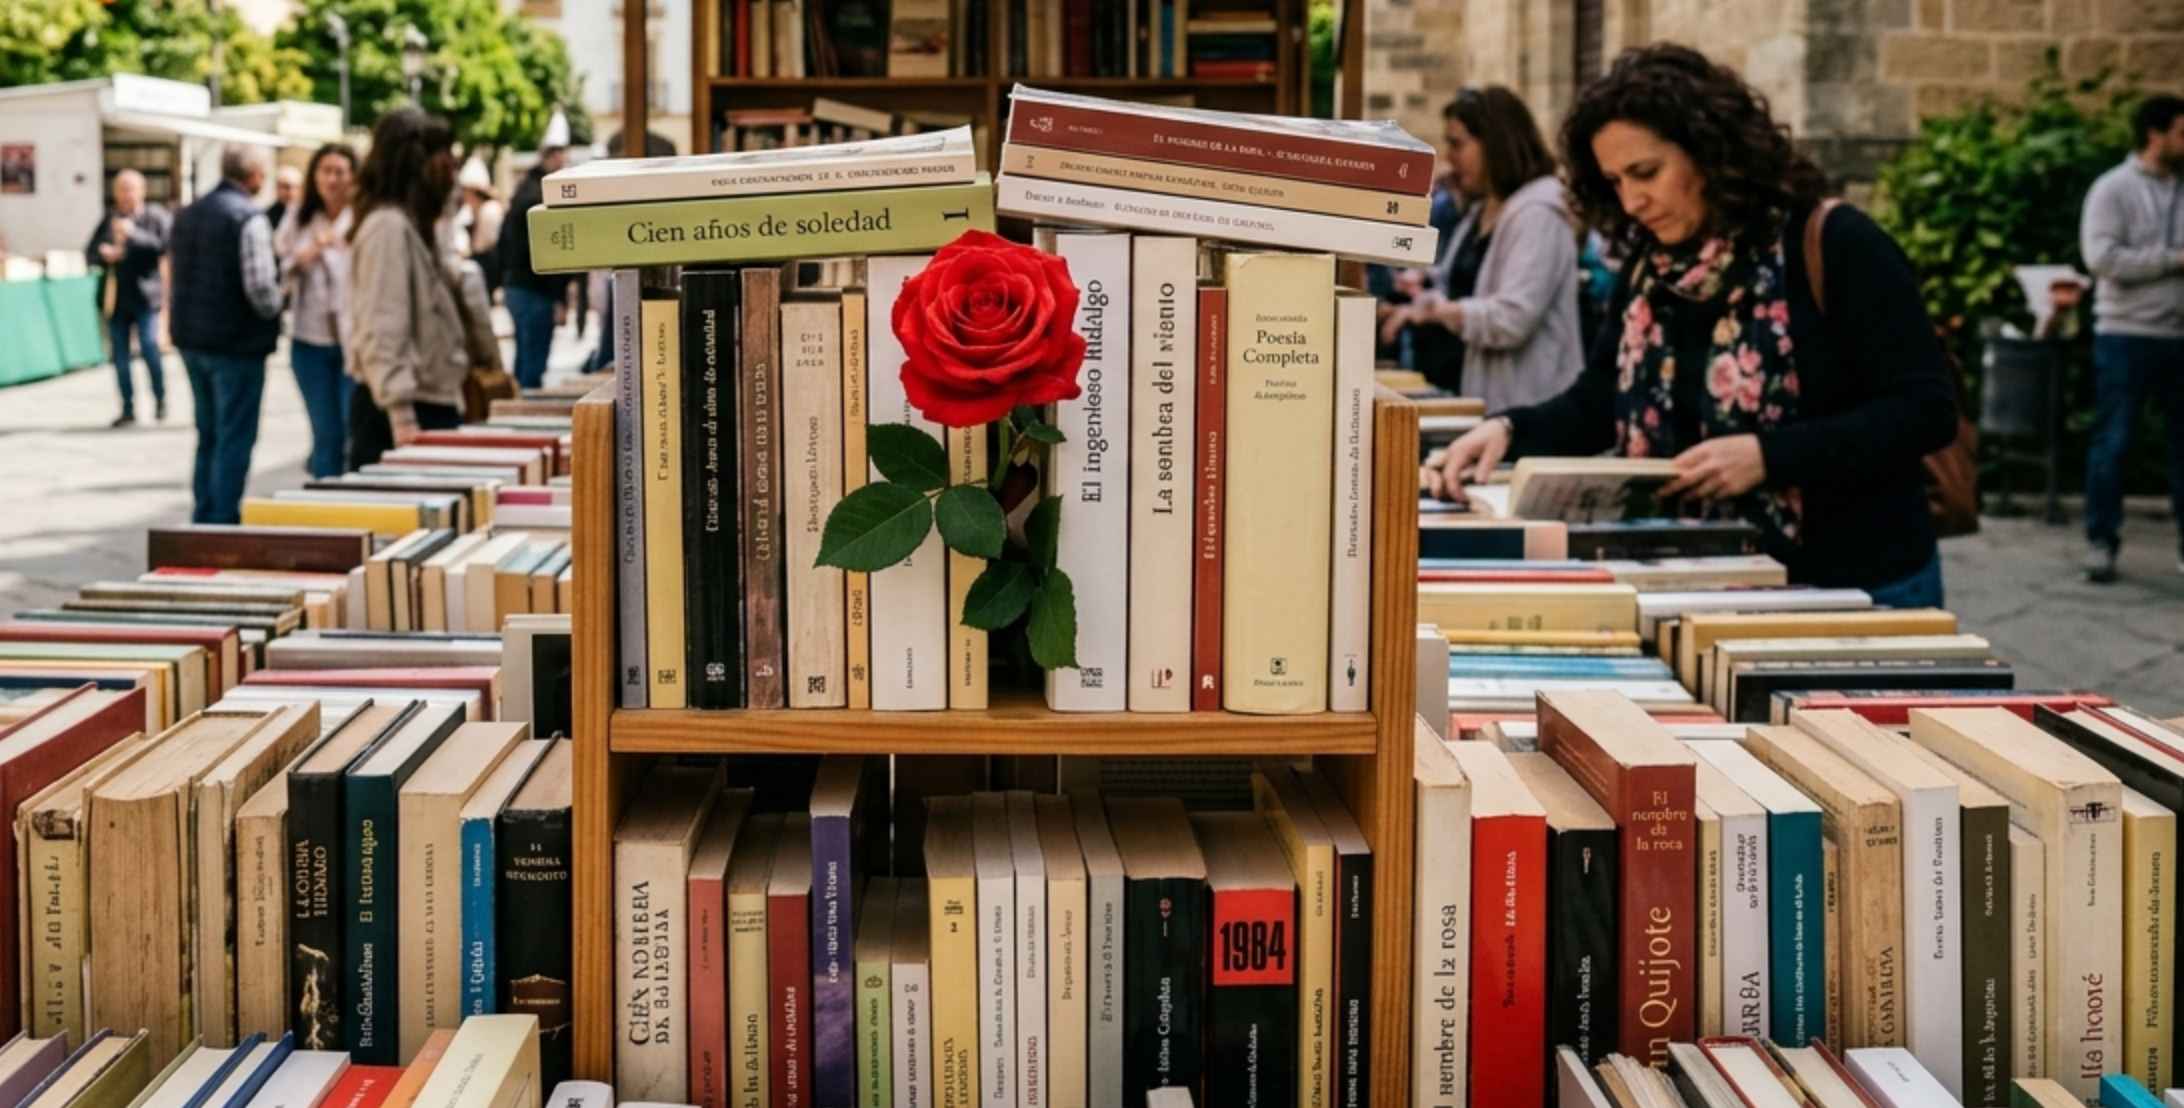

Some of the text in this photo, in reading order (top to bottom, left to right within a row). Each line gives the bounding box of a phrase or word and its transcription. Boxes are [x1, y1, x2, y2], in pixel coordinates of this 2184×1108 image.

[627, 207, 892, 244] Cien años de soledad
[1242, 347, 1320, 368] Completa
[1151, 361, 1174, 395] del
[1440, 903, 1458, 950] rosa
[1220, 920, 1287, 972] 1984
[1638, 905, 1682, 1028] Quijote
[1434, 985, 1457, 1011] de
